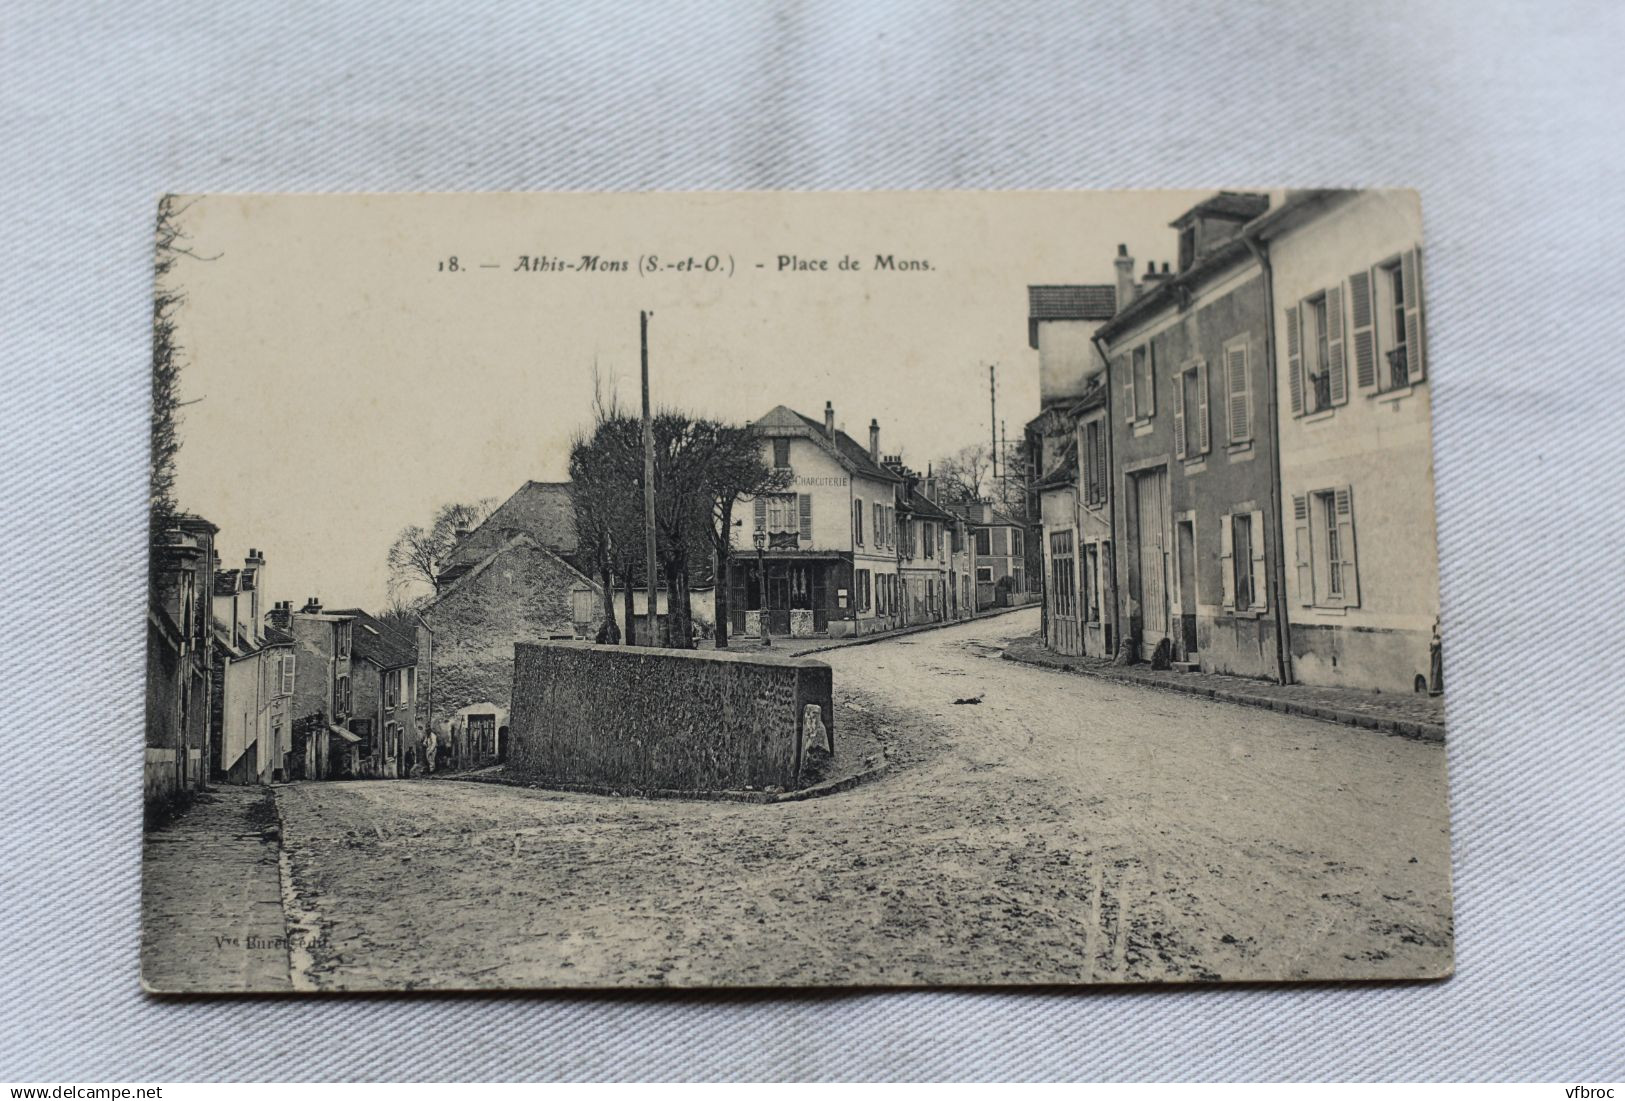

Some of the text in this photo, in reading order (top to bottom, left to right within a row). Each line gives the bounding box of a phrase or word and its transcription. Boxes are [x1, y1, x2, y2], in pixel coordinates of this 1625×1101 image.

[437, 255, 467, 273] 18.
[514, 254, 629, 273] Athis-Mons
[638, 254, 735, 278] (S.-et-O.)
[777, 254, 829, 272] Place
[838, 254, 861, 272] de
[874, 254, 937, 272] Mons.
